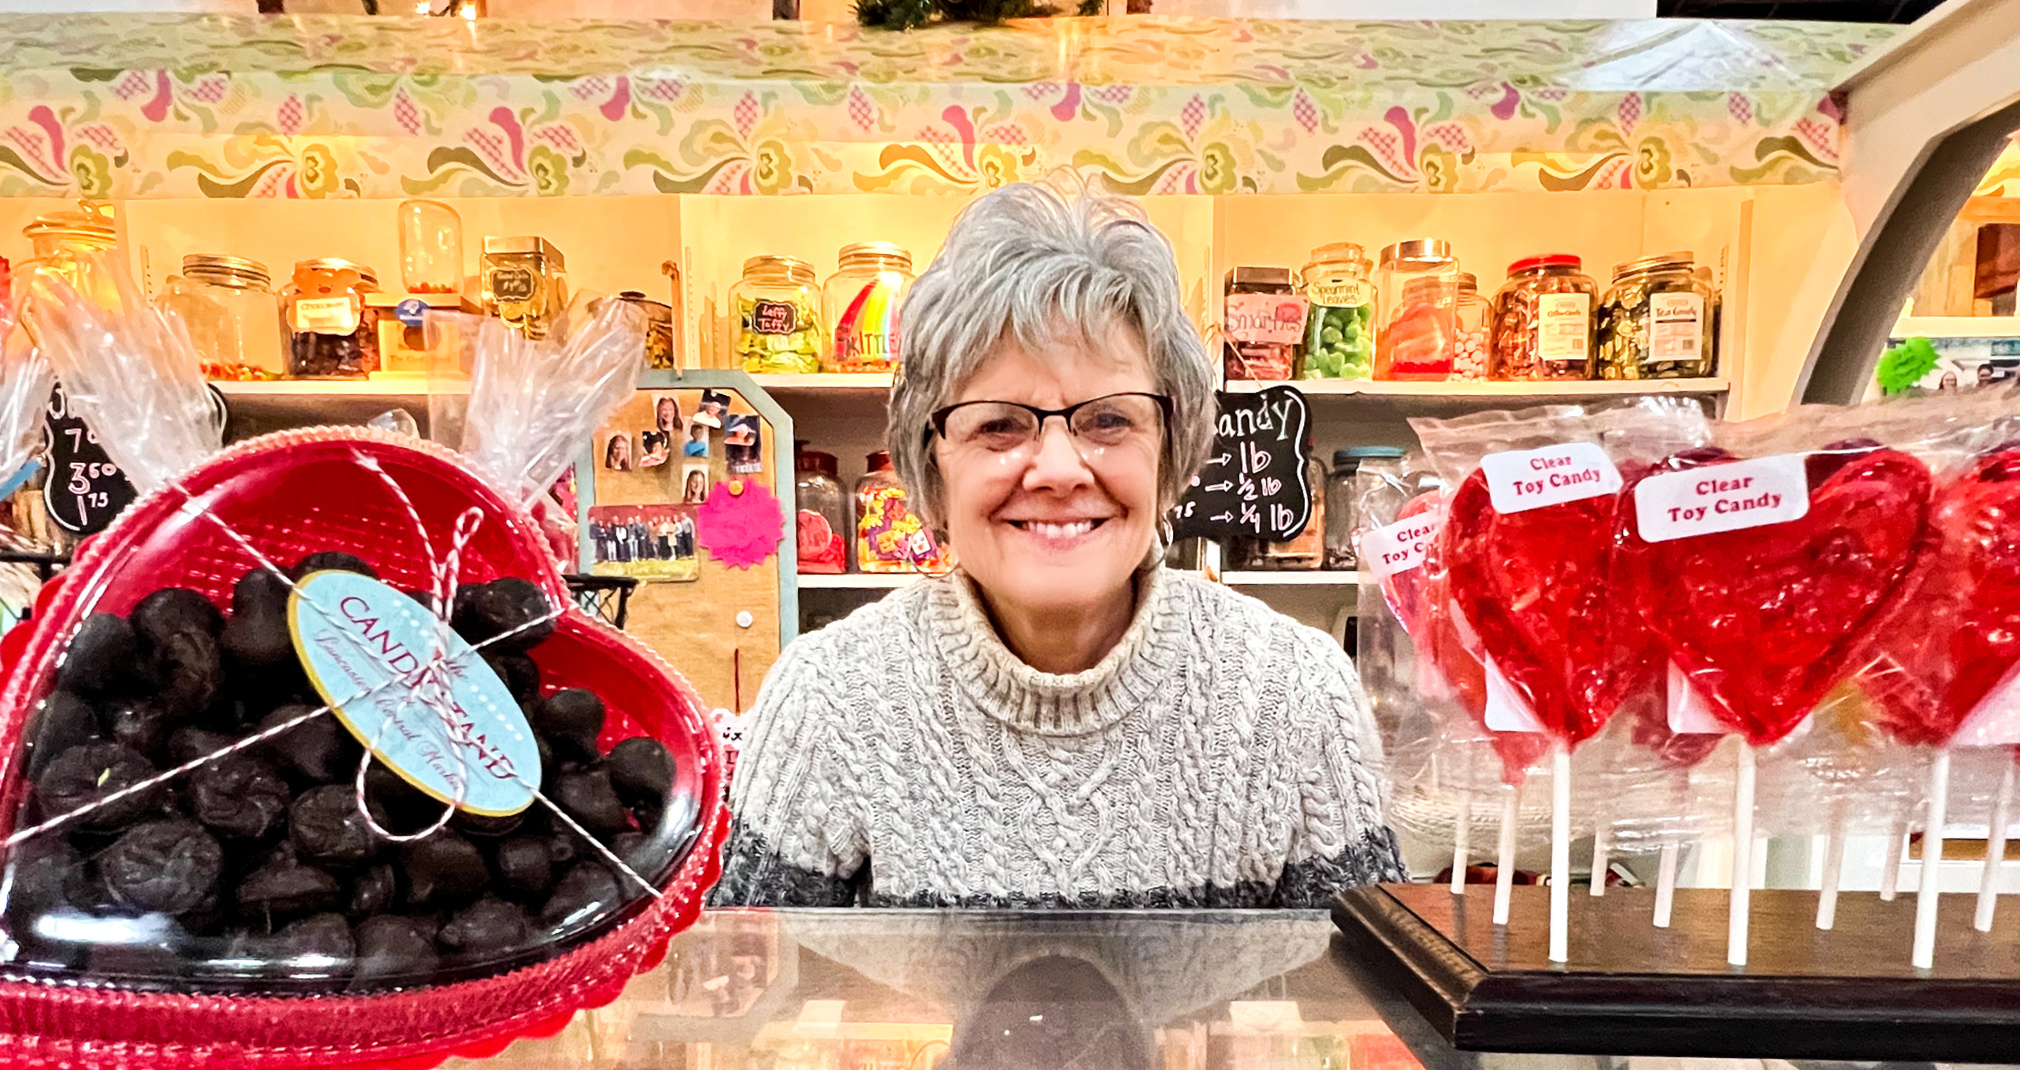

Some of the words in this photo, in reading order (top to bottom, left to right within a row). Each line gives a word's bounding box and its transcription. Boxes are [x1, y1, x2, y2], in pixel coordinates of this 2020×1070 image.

[1529, 455, 1573, 471] Clear
[1512, 478, 1545, 496] Toy
[1549, 467, 1602, 488] Candy
[1695, 476, 1755, 496] Clear
[1667, 506, 1708, 523] Toy
[1713, 491, 1783, 515] Candy
[1381, 549, 1410, 565] Toy
